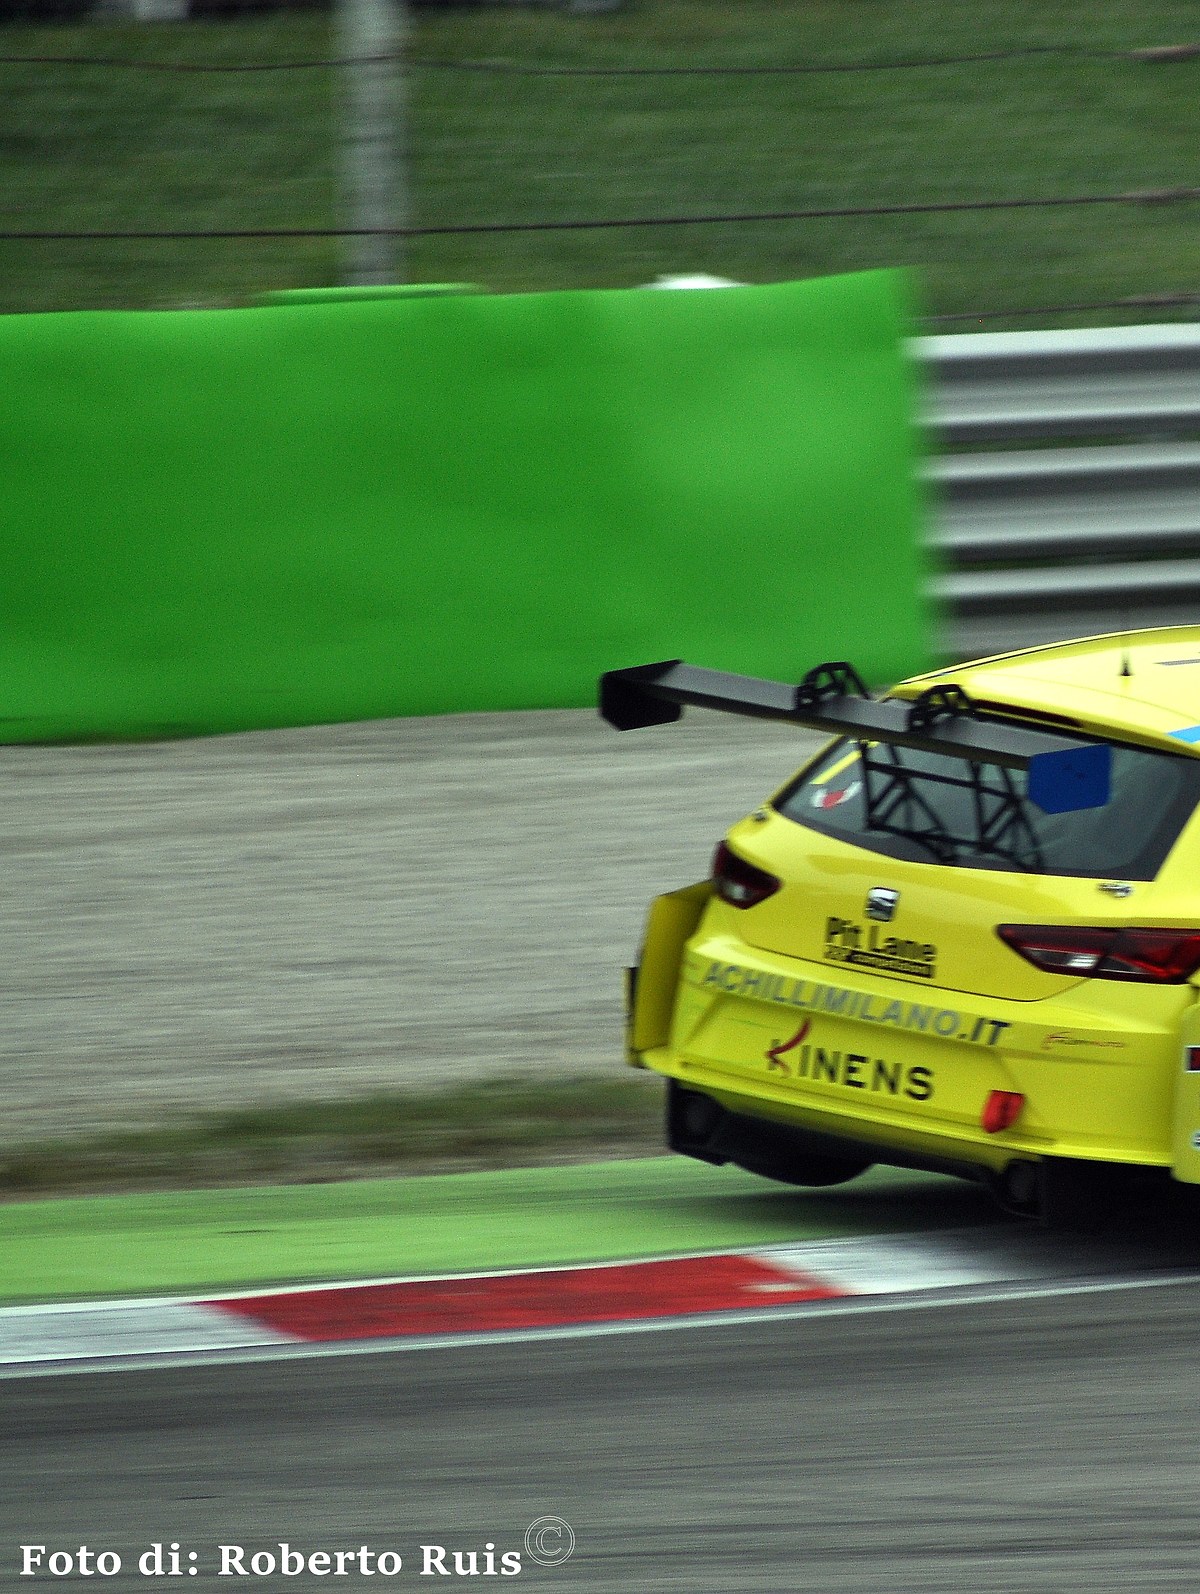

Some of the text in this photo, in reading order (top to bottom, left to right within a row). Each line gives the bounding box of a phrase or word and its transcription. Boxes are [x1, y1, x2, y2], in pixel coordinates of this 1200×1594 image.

[825, 916, 862, 949] Pit
[867, 924, 938, 963] Lane
[702, 961, 1013, 1047] ACHILLIMILANO.IT
[764, 1018, 935, 1101] KINENS
